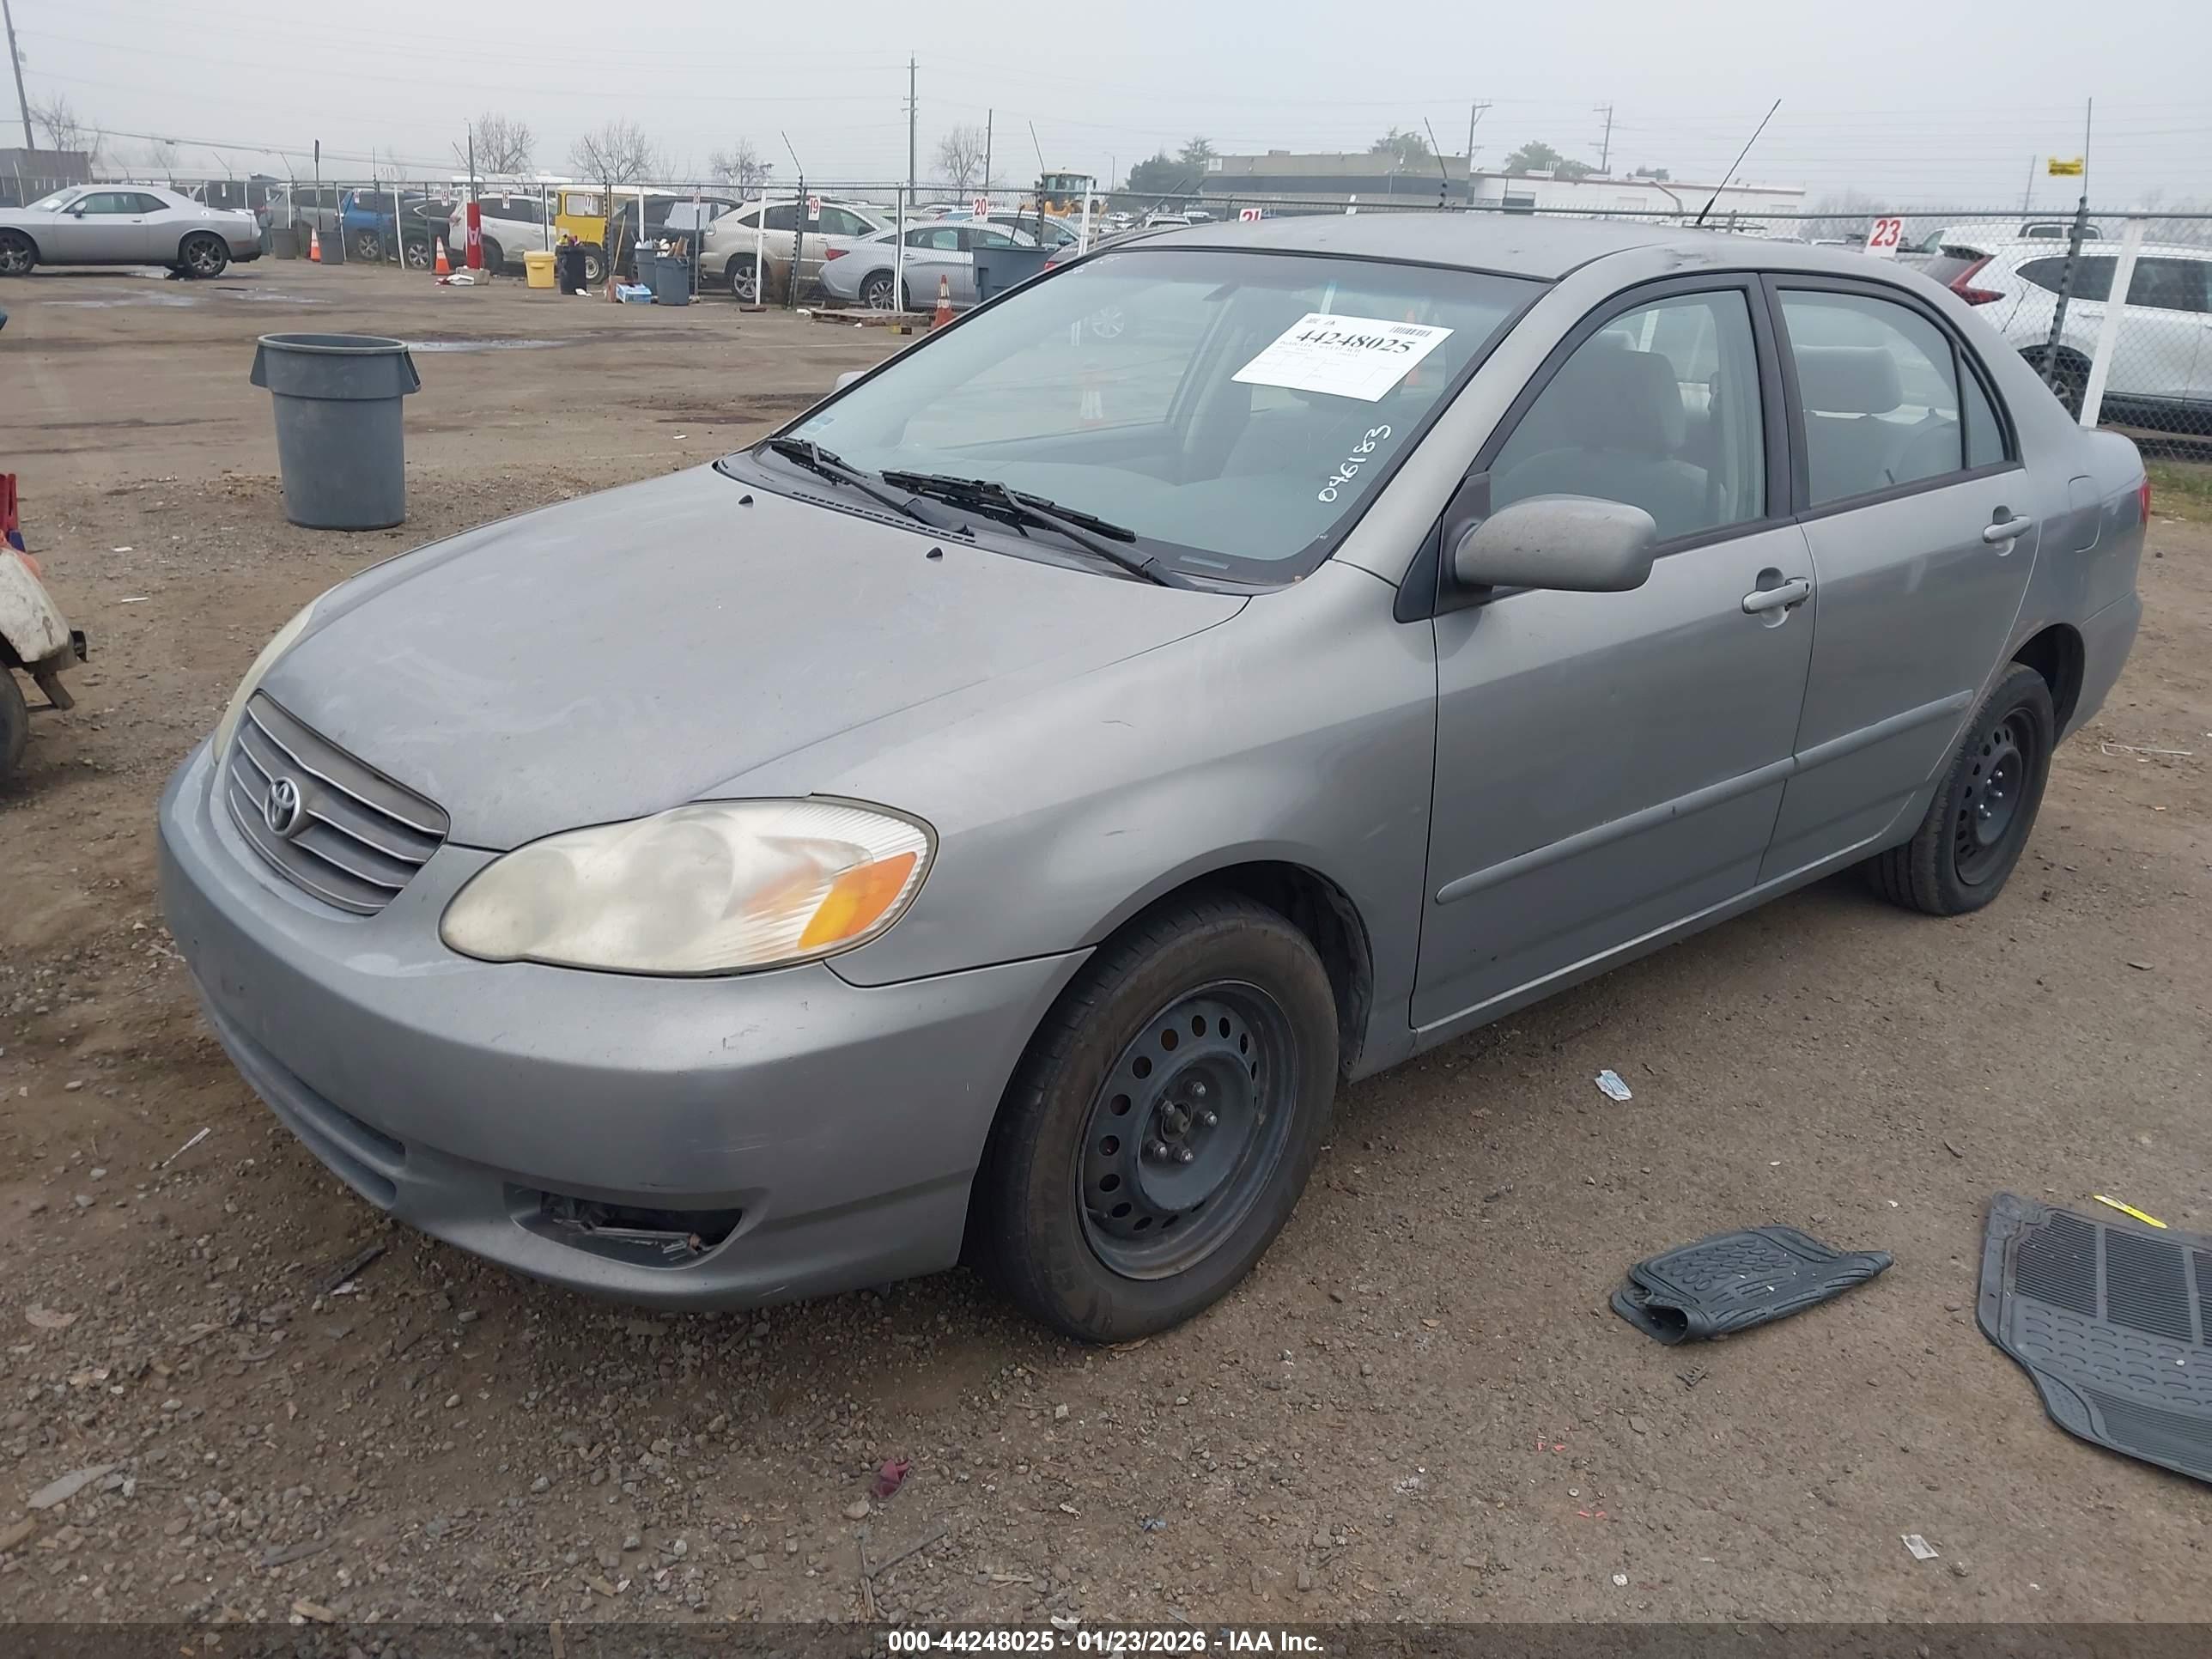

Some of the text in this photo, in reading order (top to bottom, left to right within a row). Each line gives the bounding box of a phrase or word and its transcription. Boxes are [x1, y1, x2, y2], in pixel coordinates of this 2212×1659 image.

[810, 198, 819, 214] 19
[975, 198, 987, 216] 20
[1870, 219, 1901, 246] 23
[1296, 330, 1417, 354] 44248025
[1318, 424, 1391, 502] 046183
